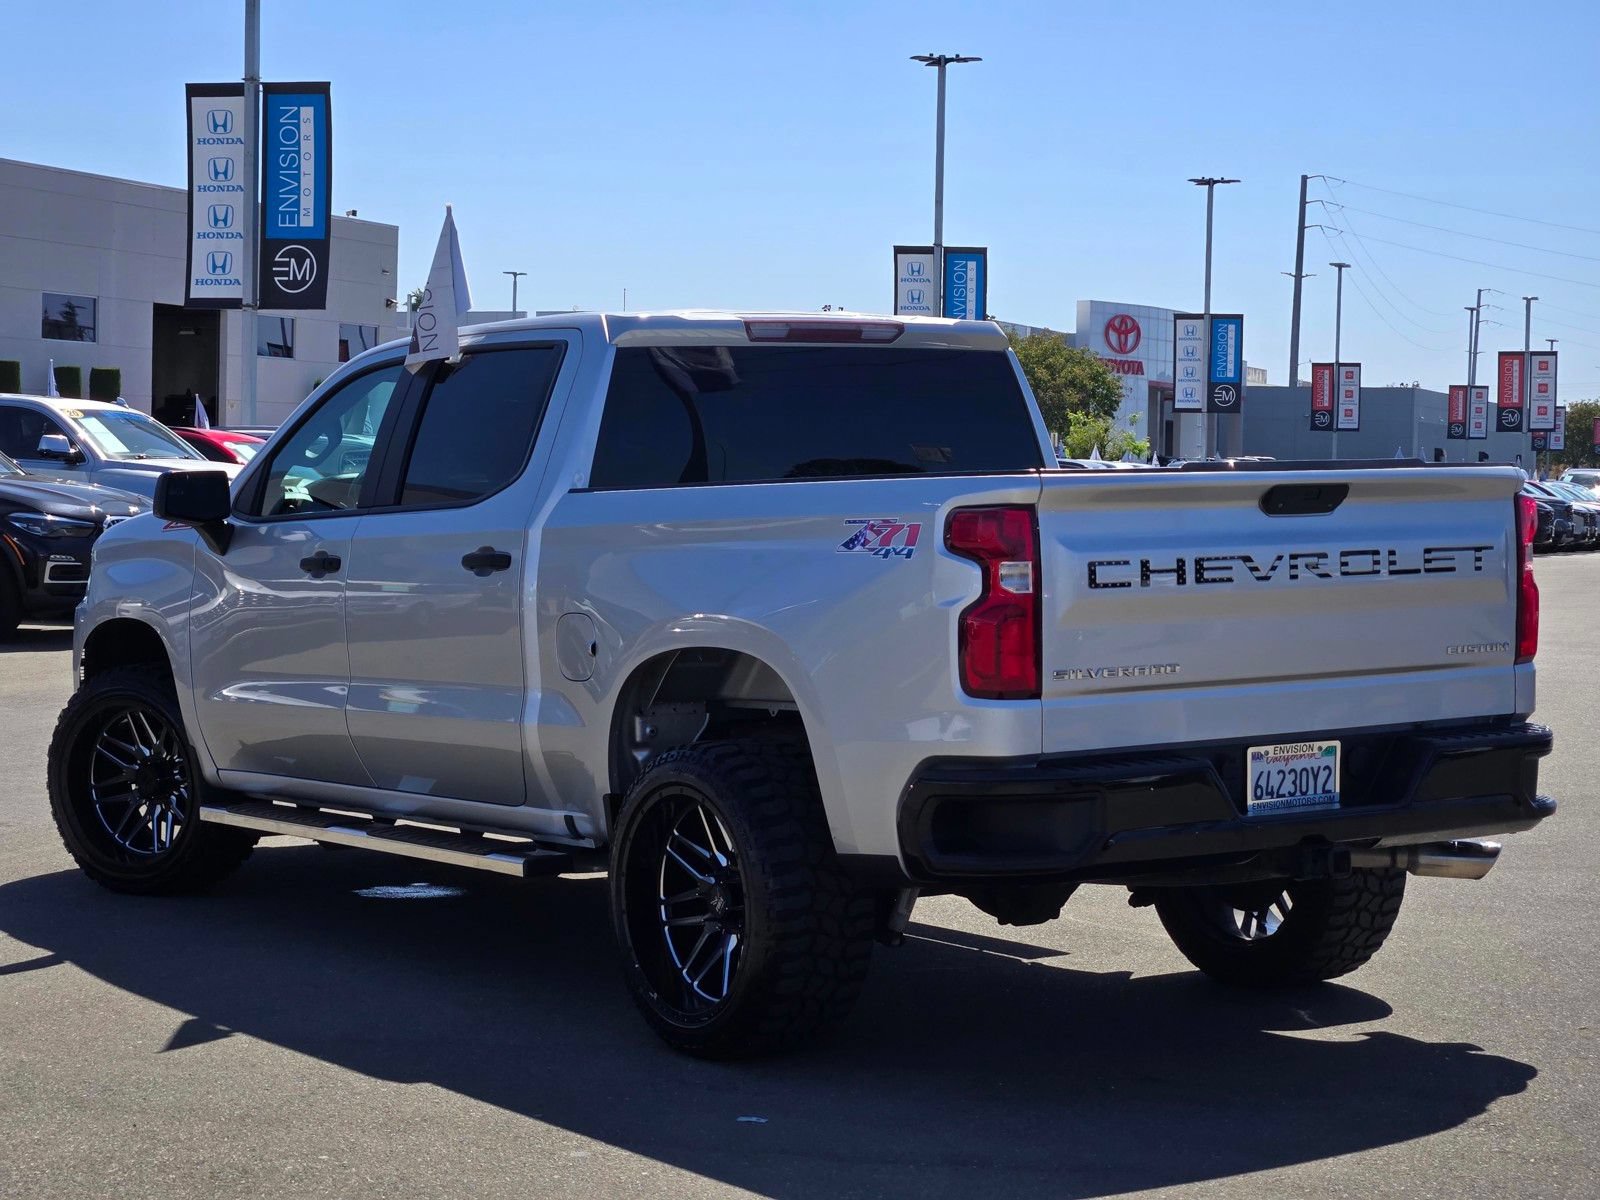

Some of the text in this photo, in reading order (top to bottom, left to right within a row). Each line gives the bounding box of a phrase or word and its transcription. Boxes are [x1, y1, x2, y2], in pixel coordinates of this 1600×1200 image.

[196, 137, 244, 145] HONDA
[278, 106, 298, 228] ENVISION
[303, 117, 312, 217] MOTORS
[197, 184, 245, 193] HONDA
[196, 231, 244, 240] HONDA
[195, 278, 241, 286] HONDA
[953, 260, 966, 319] NVISION
[1216, 323, 1227, 378] ENVISION
[1504, 359, 1513, 404] ENVISION
[1086, 545, 1495, 590] CHEVROLET
[1447, 642, 1510, 656] CUSTOM
[1052, 663, 1181, 681] SILVERADO
[1273, 744, 1314, 755] ENVISION
[1253, 764, 1333, 801] 64230Y2
[1252, 796, 1334, 809] ENVISIONMOTORS.COM
